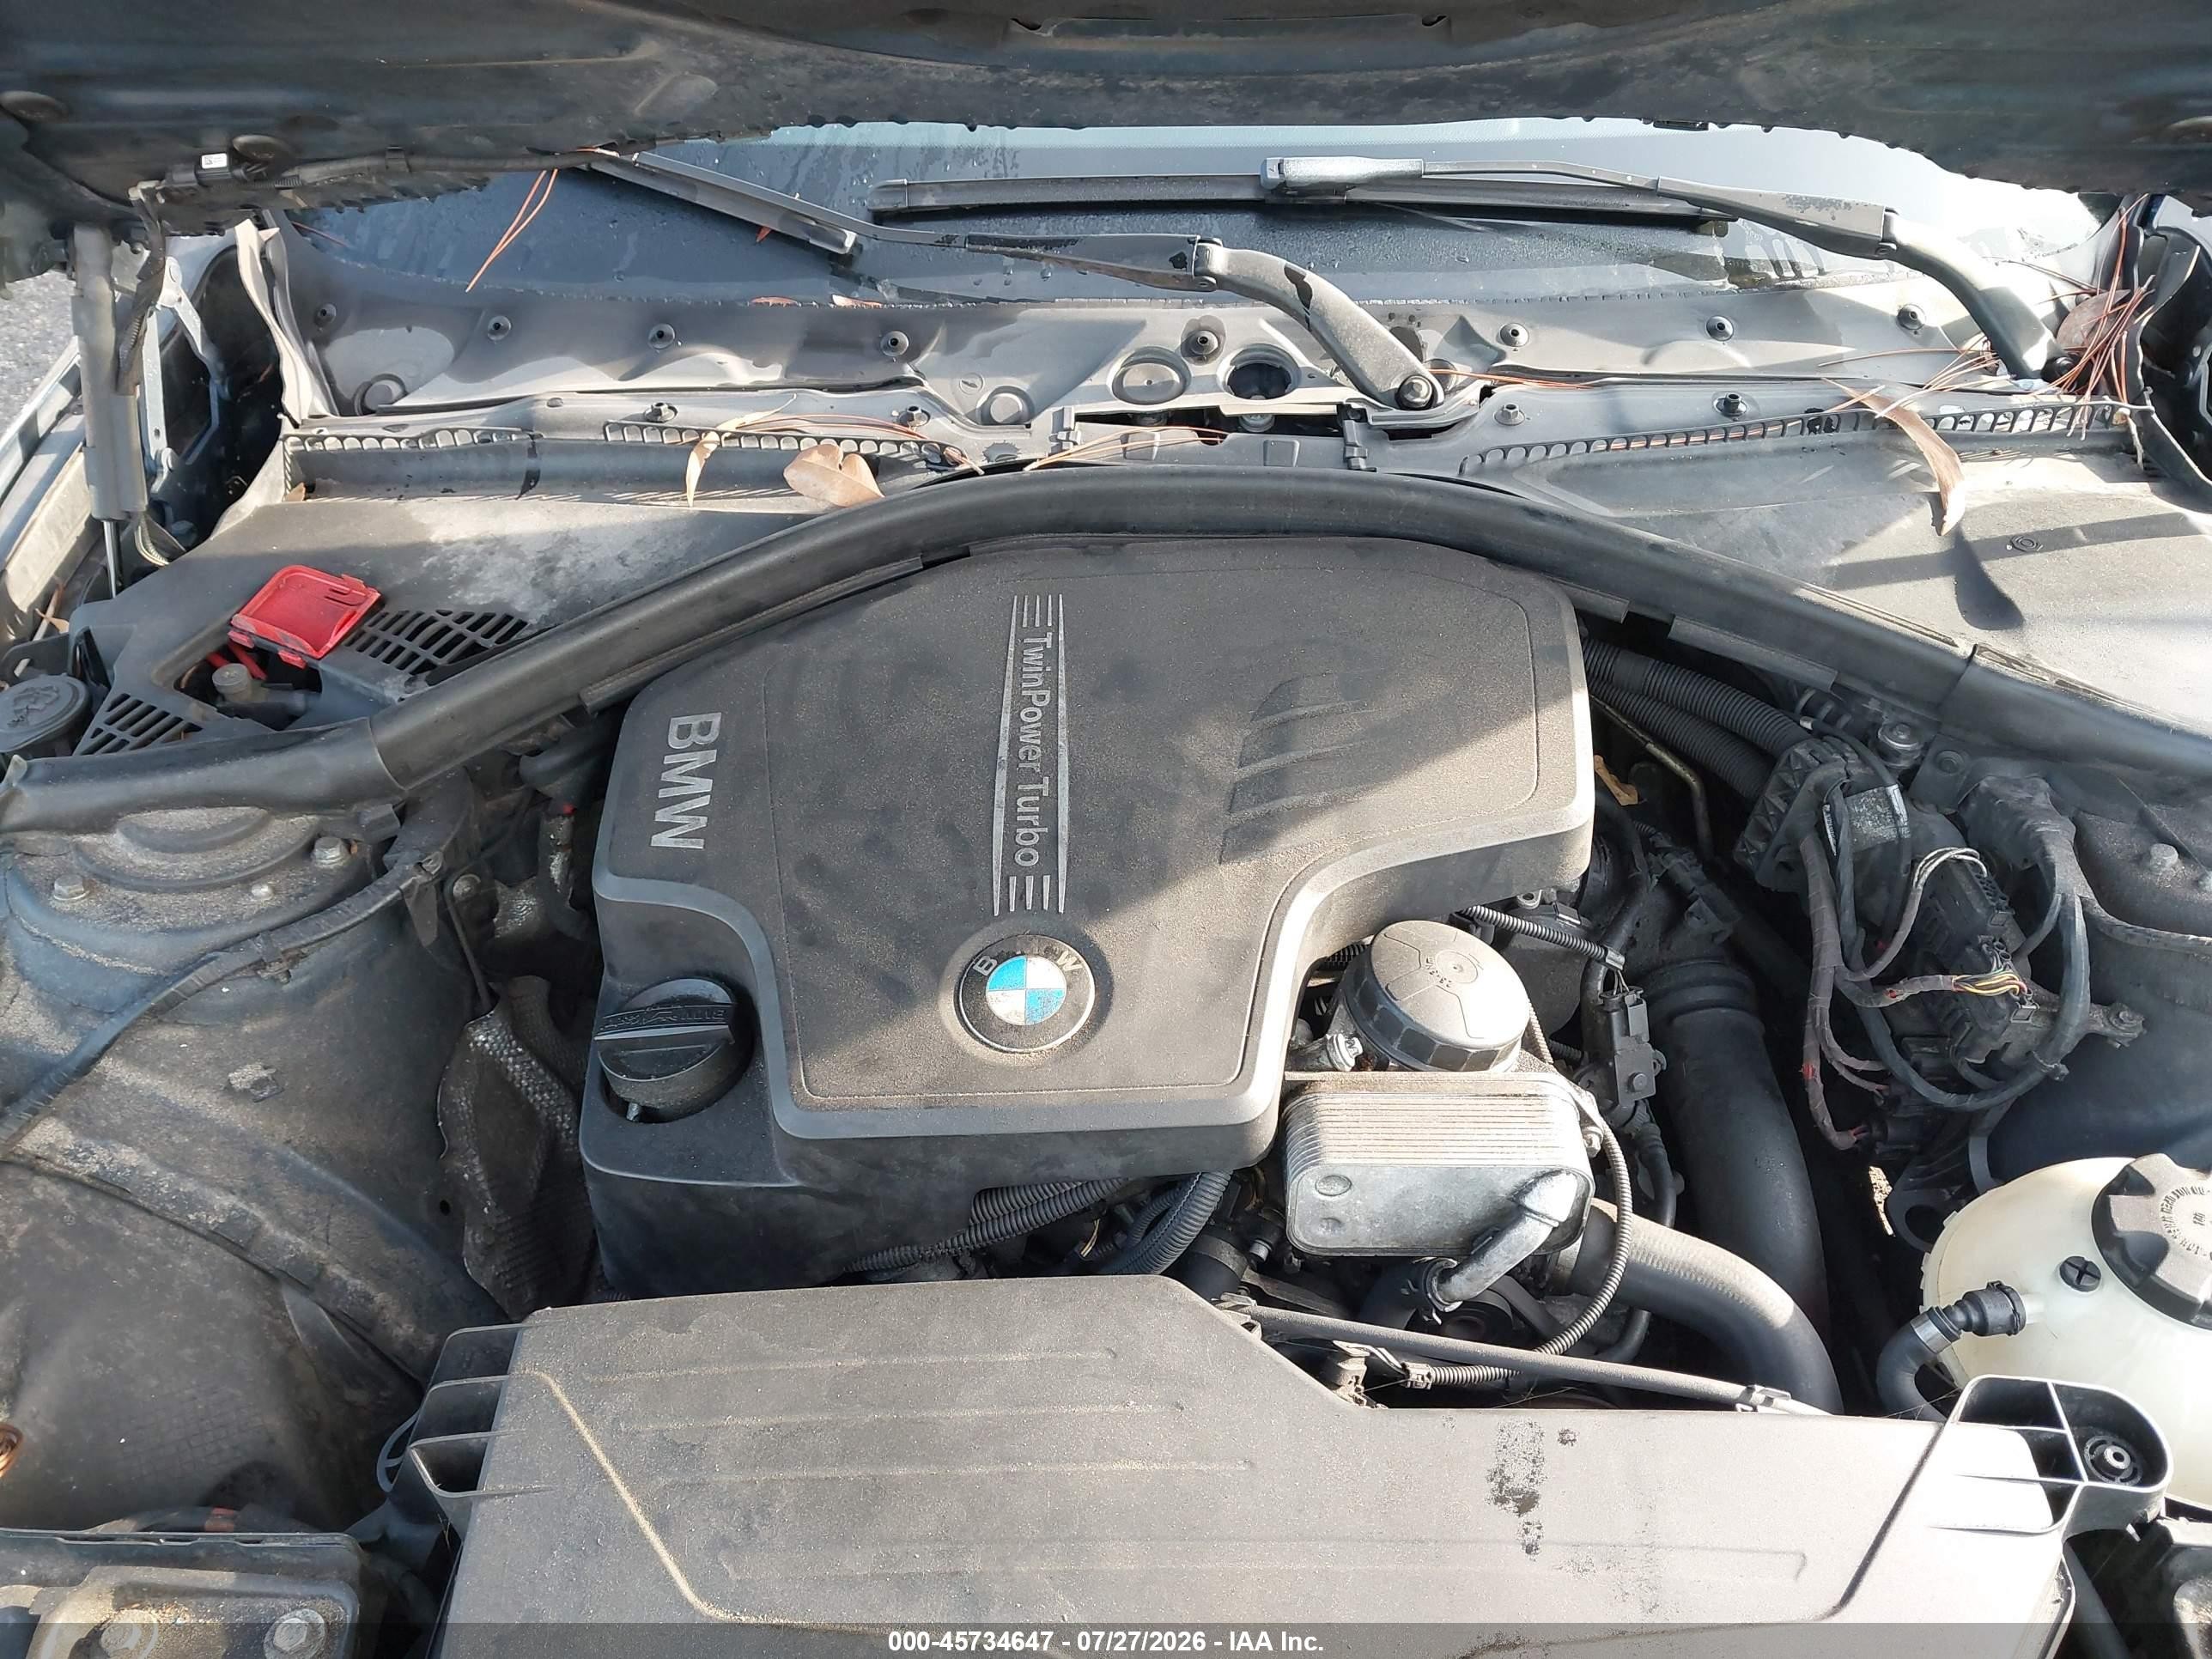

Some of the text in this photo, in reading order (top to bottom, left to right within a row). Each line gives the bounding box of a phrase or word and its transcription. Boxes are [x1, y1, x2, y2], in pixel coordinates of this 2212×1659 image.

[650, 712, 722, 849] BMW
[1013, 631, 1054, 867] TwinPower Turbo
[972, 947, 1084, 977] BW
